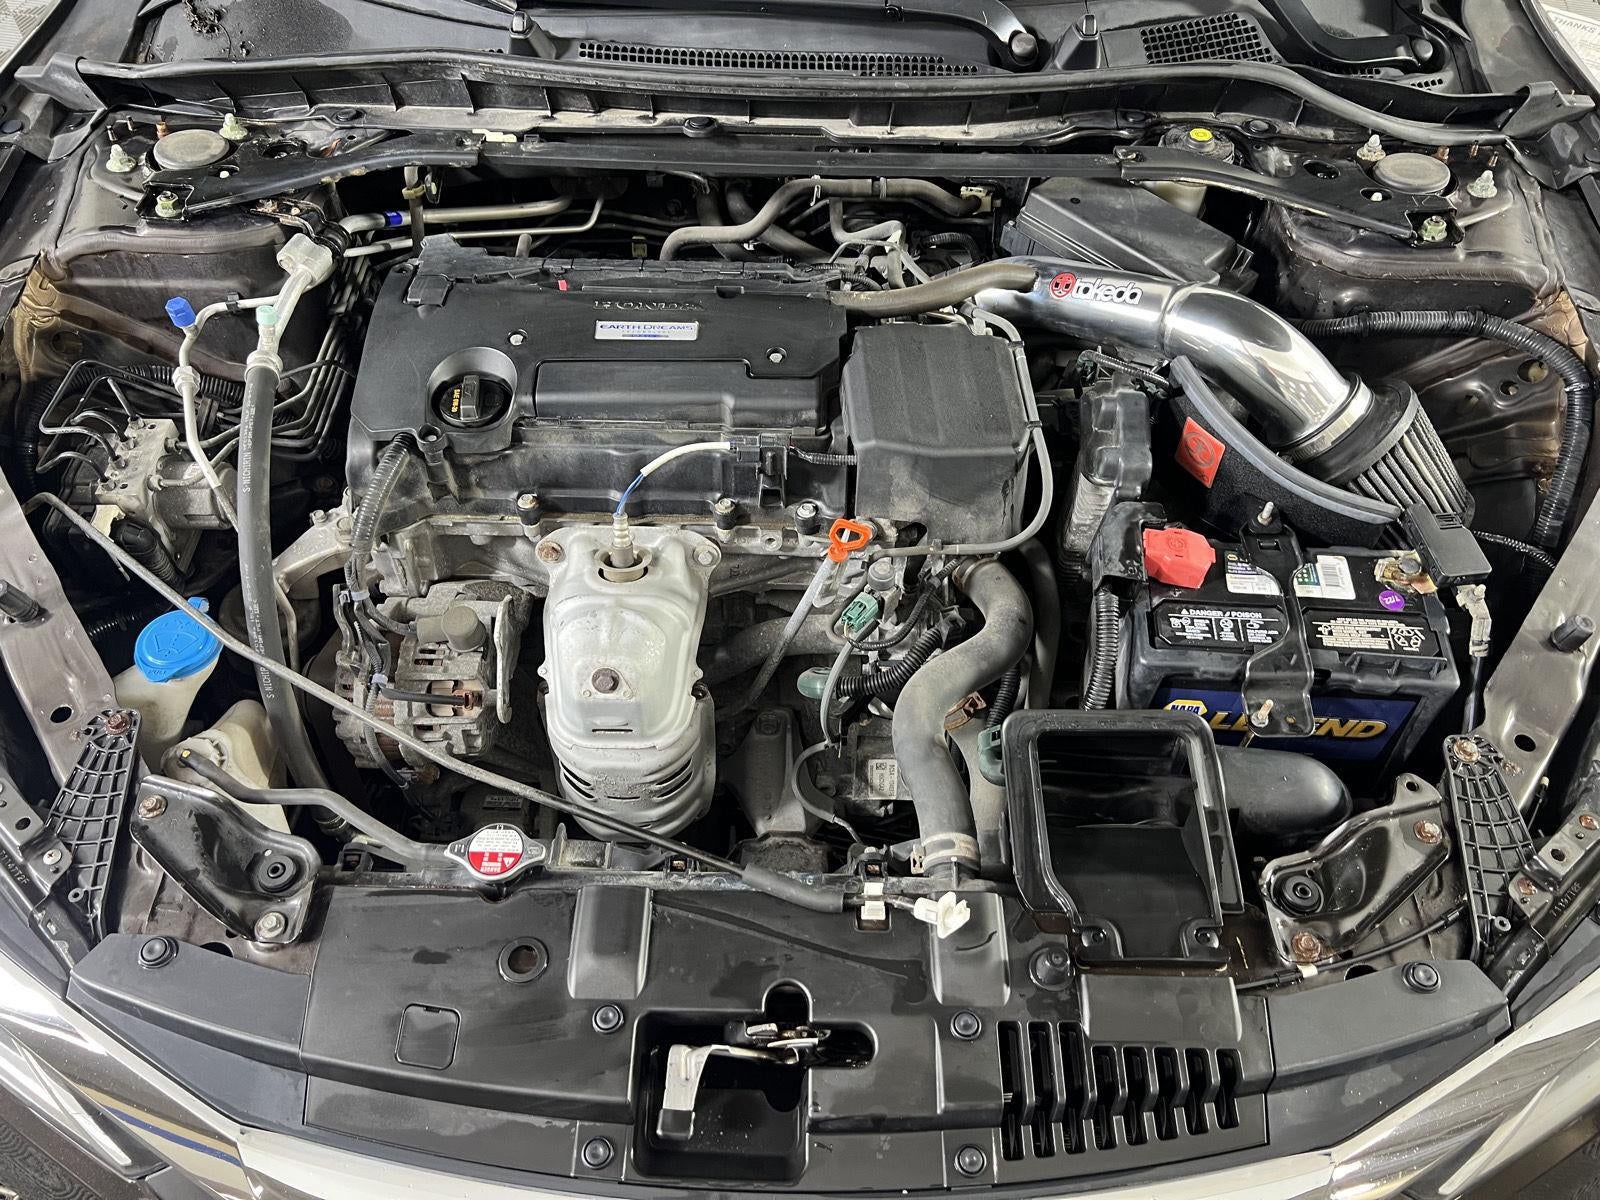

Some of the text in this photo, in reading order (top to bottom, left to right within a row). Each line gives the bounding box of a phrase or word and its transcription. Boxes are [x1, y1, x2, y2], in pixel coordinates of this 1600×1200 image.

[1553, 15, 1597, 34] THANKS
[1071, 276, 1143, 305] takeda
[600, 323, 641, 331] EARTH
[643, 324, 693, 332] DREAMS
[1189, 609, 1223, 617] DANGER
[1231, 611, 1263, 619] POISON
